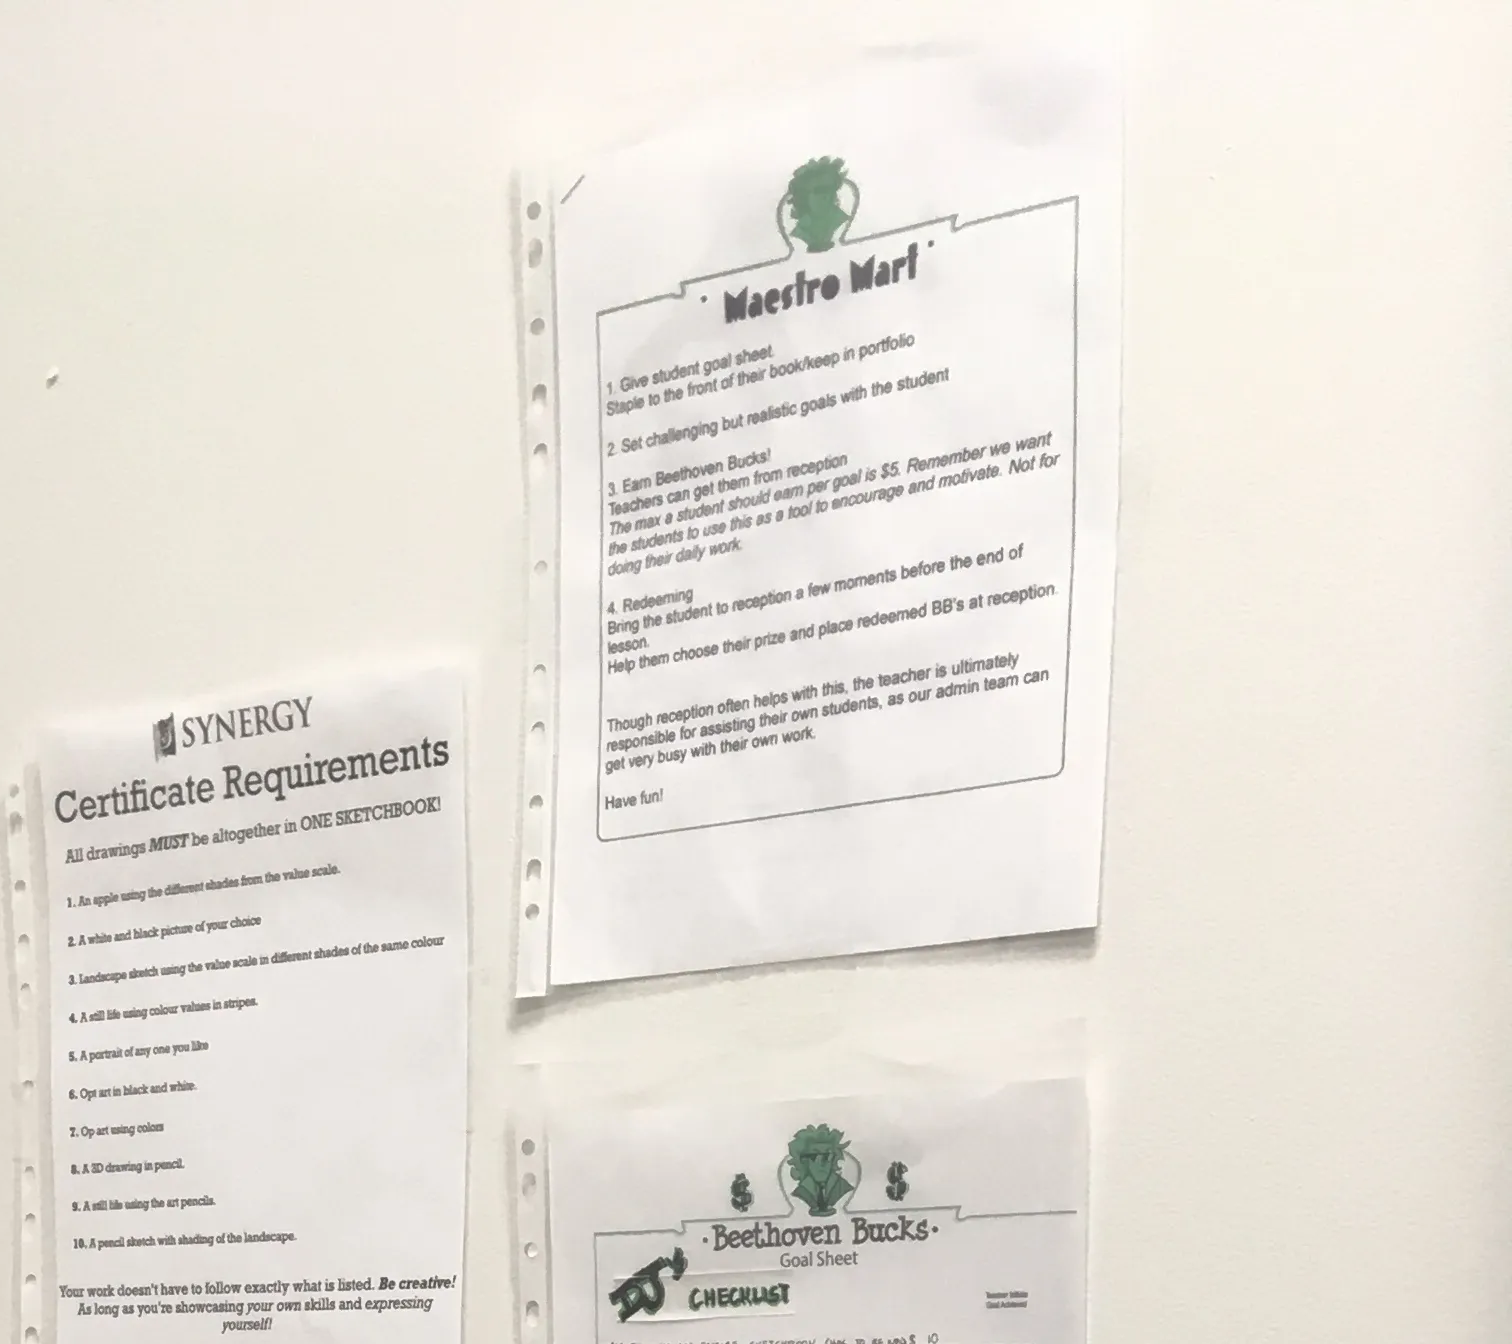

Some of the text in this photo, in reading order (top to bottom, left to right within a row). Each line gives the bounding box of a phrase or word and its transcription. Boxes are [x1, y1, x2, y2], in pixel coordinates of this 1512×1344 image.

[723, 243, 920, 323] Maestro Mart
[607, 543, 1025, 636] Bring the student to reception a few moments before the end of
[607, 657, 637, 675] Help
[638, 652, 670, 670] them
[672, 643, 720, 663] choose
[722, 635, 753, 655] their
[753, 631, 787, 651] prize
[788, 623, 816, 642] and
[817, 619, 854, 640] place
[856, 602, 928, 629] redeemed
[931, 597, 965, 616] BB's
[968, 593, 984, 610] at
[605, 669, 1050, 753] responsible for assisting their own students, as our admin team can
[606, 712, 654, 733] Though
[656, 704, 715, 725] reception
[716, 698, 751, 715] often
[752, 691, 789, 709] helps
[790, 684, 819, 702] with
[852, 675, 875, 692] the
[876, 667, 932, 688] teacher
[934, 662, 948, 679] is
[951, 652, 1020, 676] ultimately
[181, 696, 313, 749] SYNERGY
[54, 736, 450, 824] Certificate Requirements
[604, 755, 626, 776] get
[627, 754, 655, 769] very
[656, 748, 688, 764] busy
[689, 741, 717, 758] with
[719, 735, 750, 754] their
[750, 733, 779, 749] own
[604, 787, 664, 810] Have fun!
[64, 795, 442, 864] All drawings MUST be altogether in ONE SKETCHBOOK!
[731, 1162, 909, 1213] $ $
[712, 1216, 929, 1251] Beethoven Bucks
[779, 1249, 859, 1268] Goal Sheet
[58, 1275, 457, 1299] Your work doesn't have to follow exactly what is listed. Be creative!
[76, 1296, 435, 1319] As long as you're showcasing your own skills and expressing
[689, 1283, 791, 1312] CHECKLIST
[928, 1333, 939, 1344] 10
